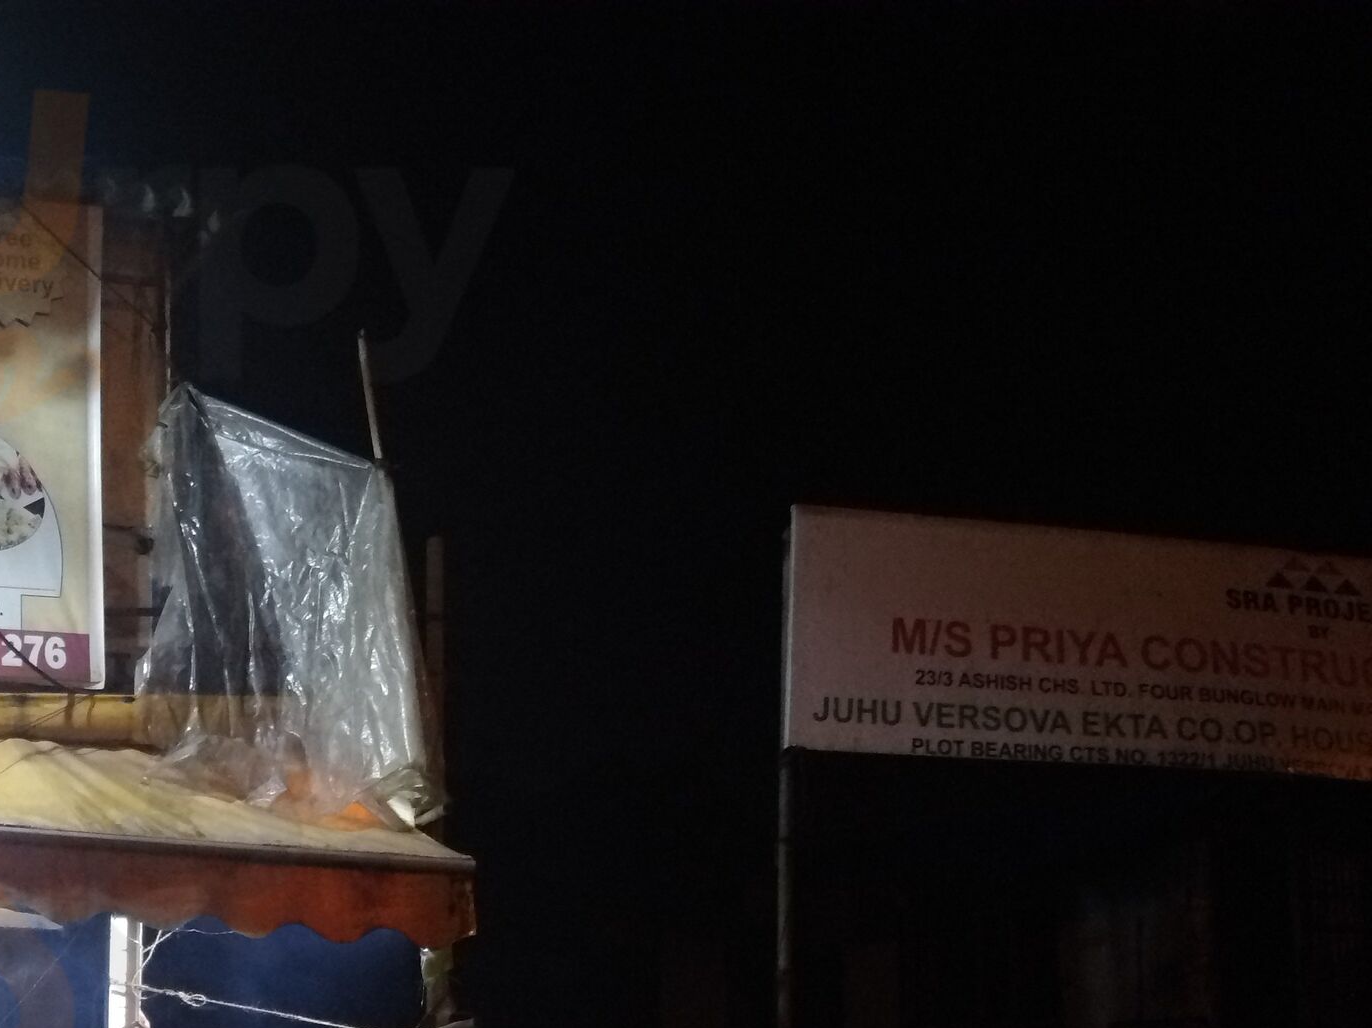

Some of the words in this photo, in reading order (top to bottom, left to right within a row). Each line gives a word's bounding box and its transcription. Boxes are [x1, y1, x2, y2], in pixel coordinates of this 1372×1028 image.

[1226, 589, 1278, 612] SRA
[1, 636, 67, 669] 276
[892, 617, 972, 658] M/S
[989, 624, 1127, 668] PRIYA
[916, 669, 953, 687] 23/3
[958, 672, 1032, 691] ASHISH
[1139, 683, 1193, 700] FOUR
[1199, 687, 1294, 708] BUNGLOW
[813, 696, 902, 726] JUHU
[912, 701, 1072, 736] VERSOVA
[1082, 711, 1168, 740] EKTA
[911, 738, 964, 756] PLOT
[971, 741, 1062, 762] BEARING
[1070, 746, 1108, 763] CTS
